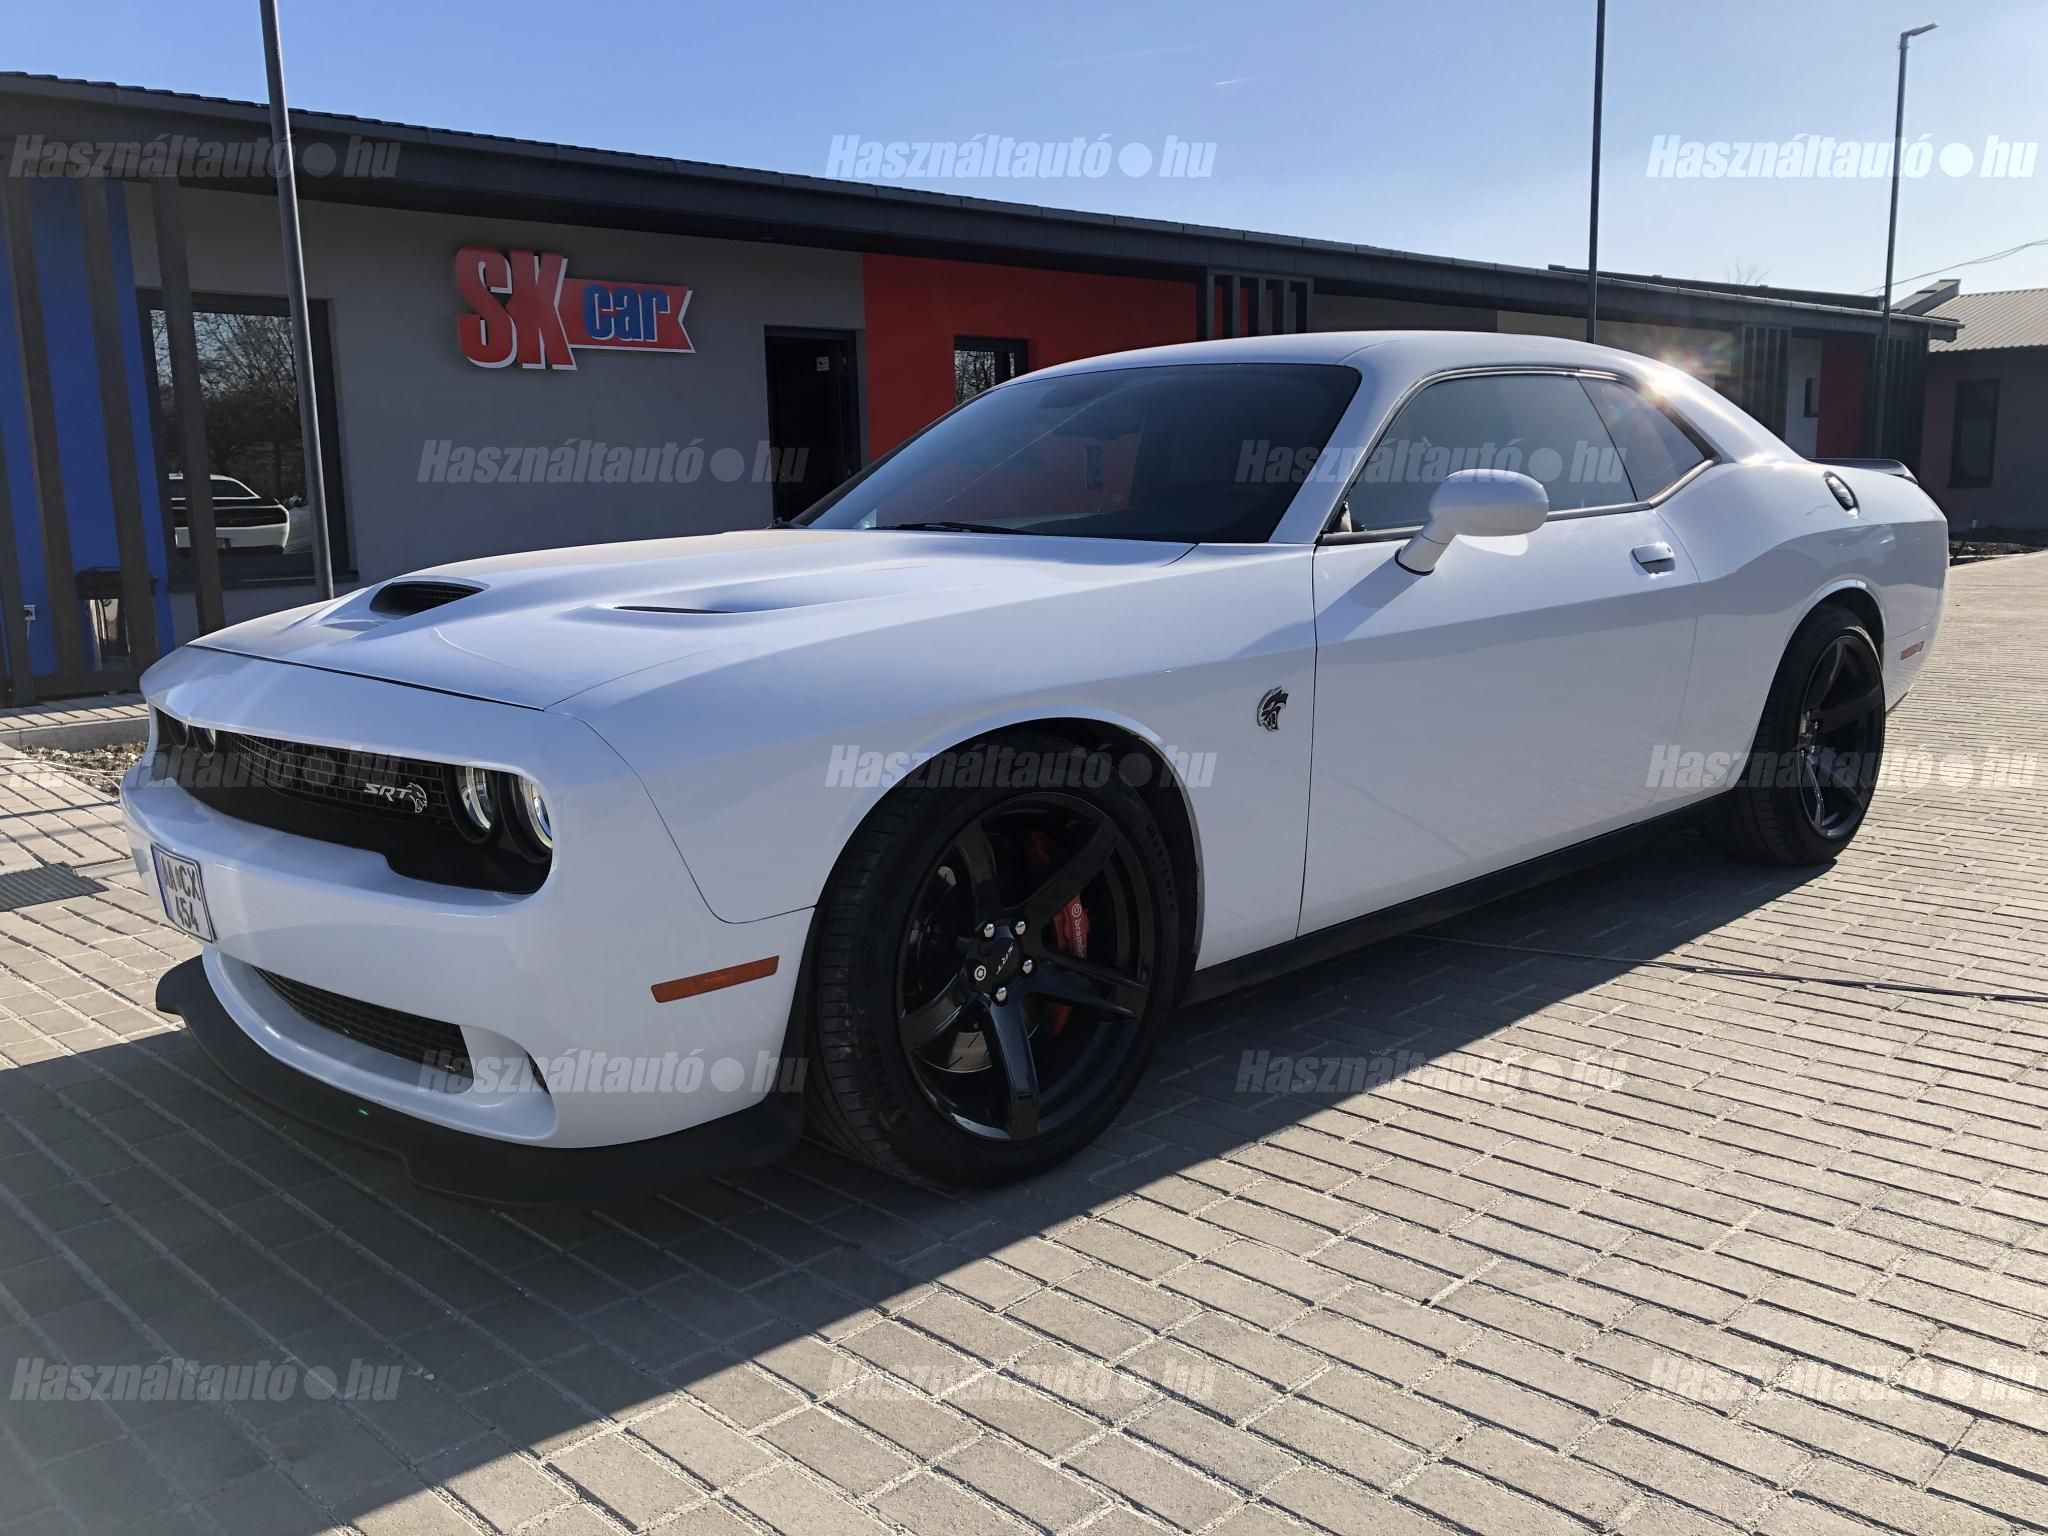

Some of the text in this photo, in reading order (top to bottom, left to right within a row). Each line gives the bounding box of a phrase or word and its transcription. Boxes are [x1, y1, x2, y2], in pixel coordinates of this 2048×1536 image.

[455, 244, 671, 371] SK car
[363, 782, 412, 802] SRT
